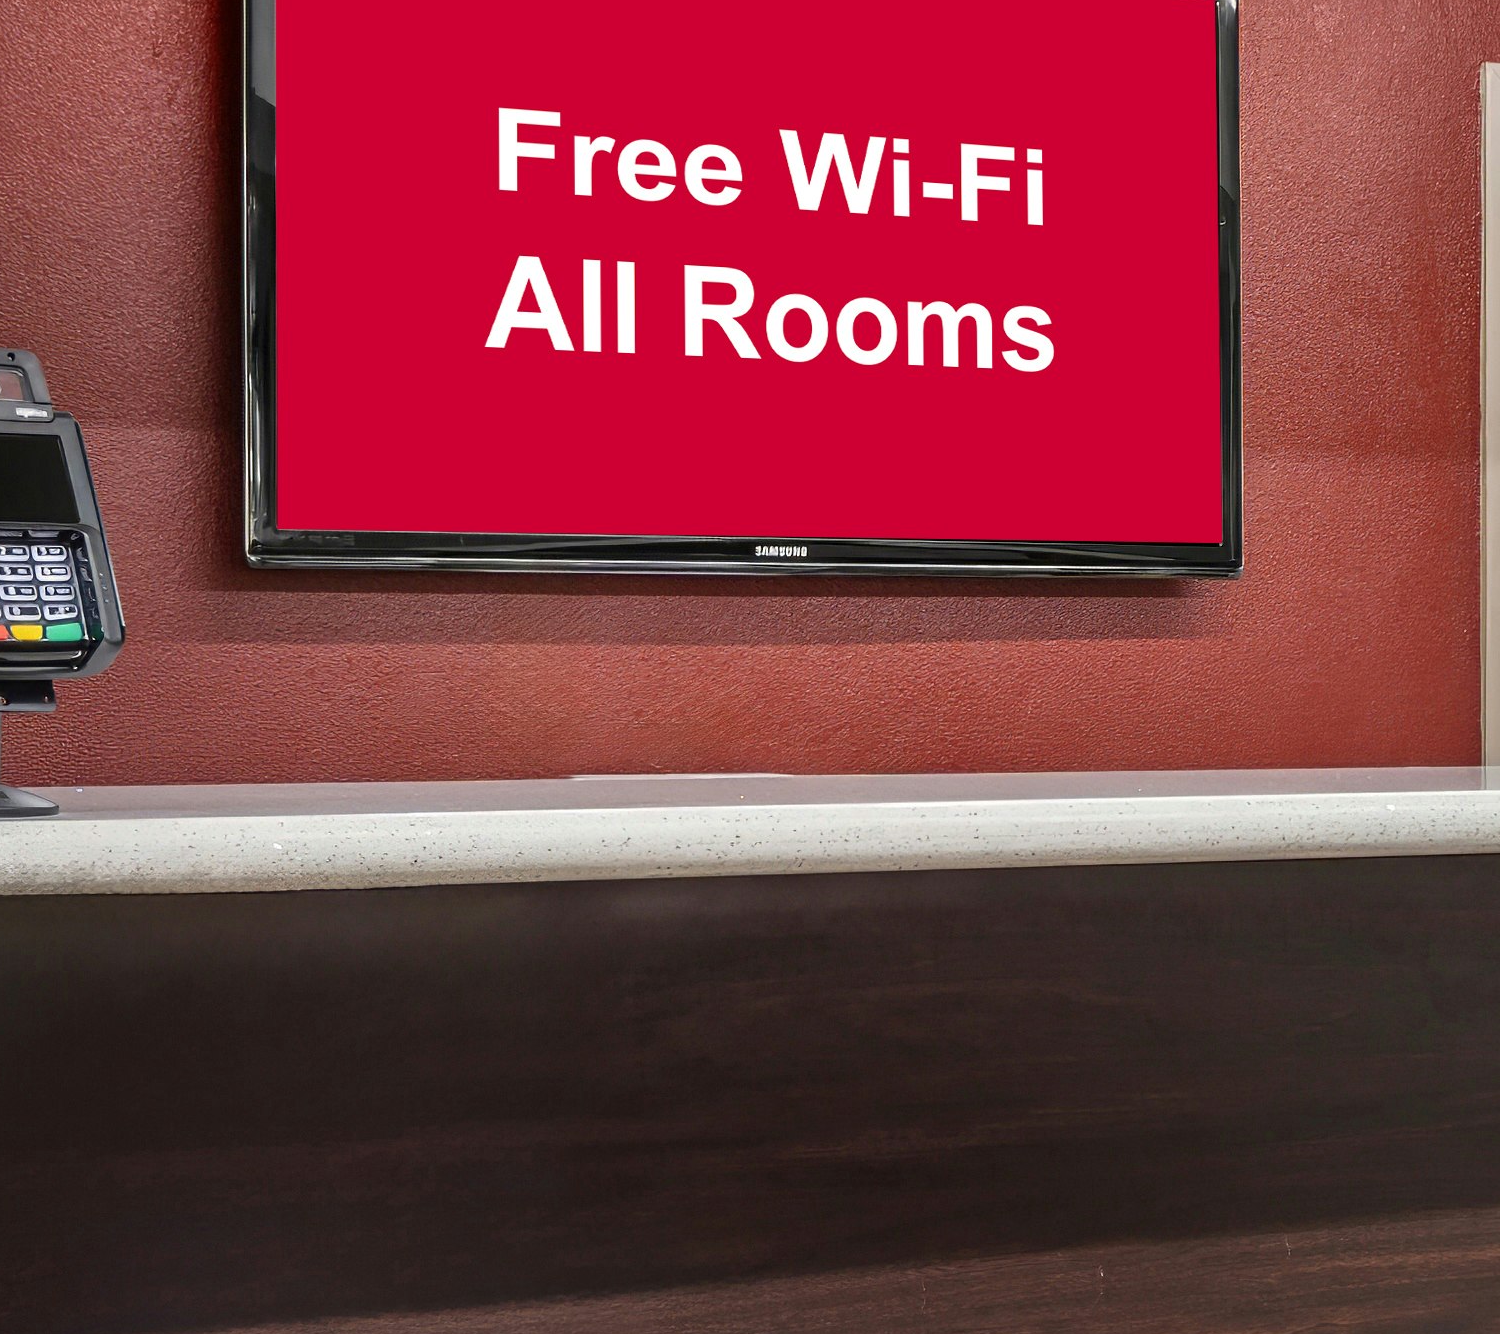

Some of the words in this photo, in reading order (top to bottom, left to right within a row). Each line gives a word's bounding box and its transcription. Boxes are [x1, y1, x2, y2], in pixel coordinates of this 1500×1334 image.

[498, 107, 743, 206] Free
[778, 129, 1044, 226] Wi-Fi
[484, 255, 636, 354] All
[683, 264, 1055, 373] Rooms
